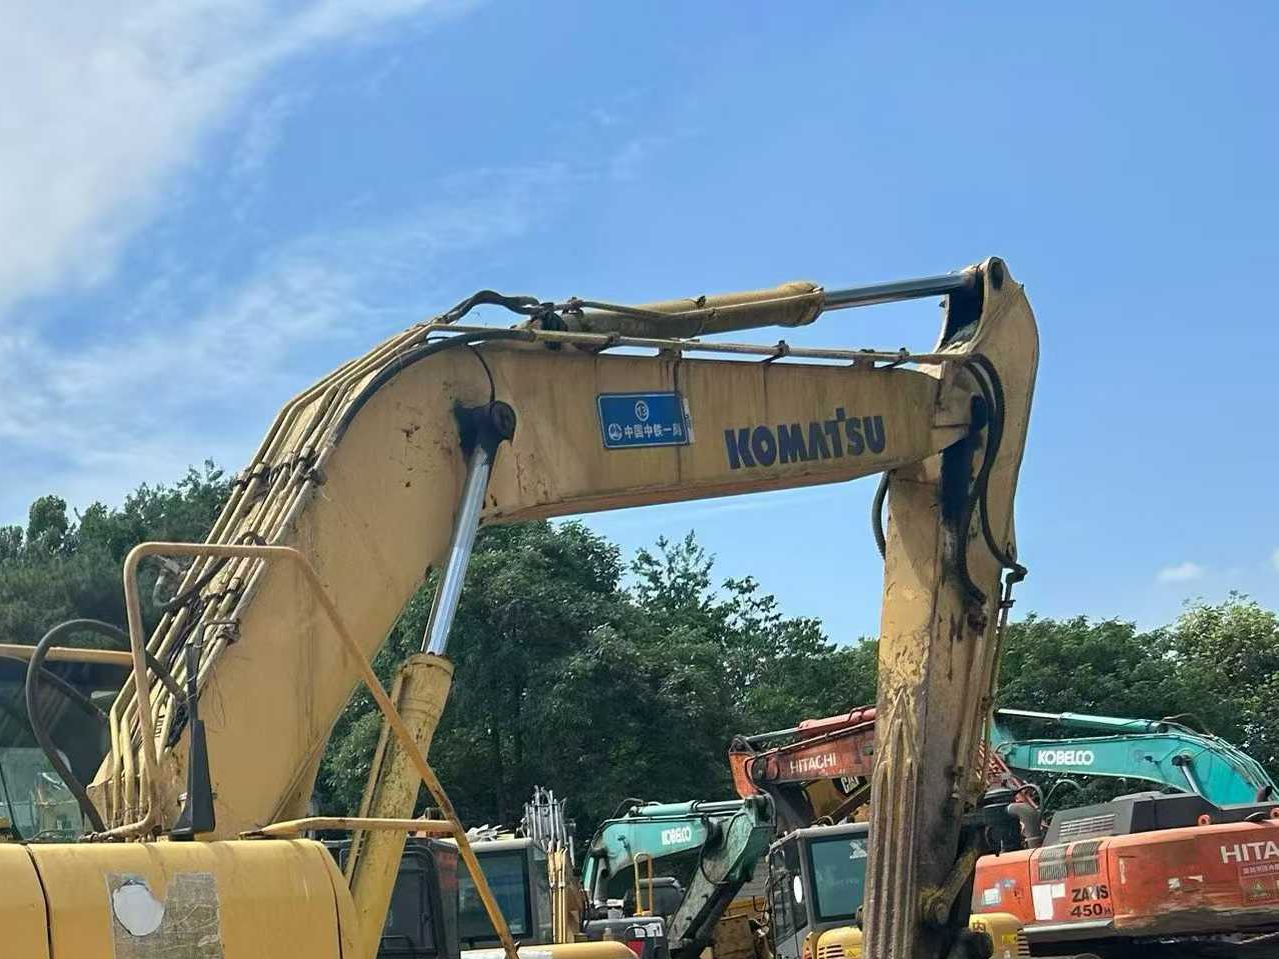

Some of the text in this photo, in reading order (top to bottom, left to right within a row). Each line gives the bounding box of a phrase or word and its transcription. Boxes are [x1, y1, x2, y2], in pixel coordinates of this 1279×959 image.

[724, 407, 887, 470] KOMATSU
[790, 753, 837, 774] HITACHI
[1037, 750, 1094, 765] KOBELCO
[1071, 884, 1109, 903] ZAIS
